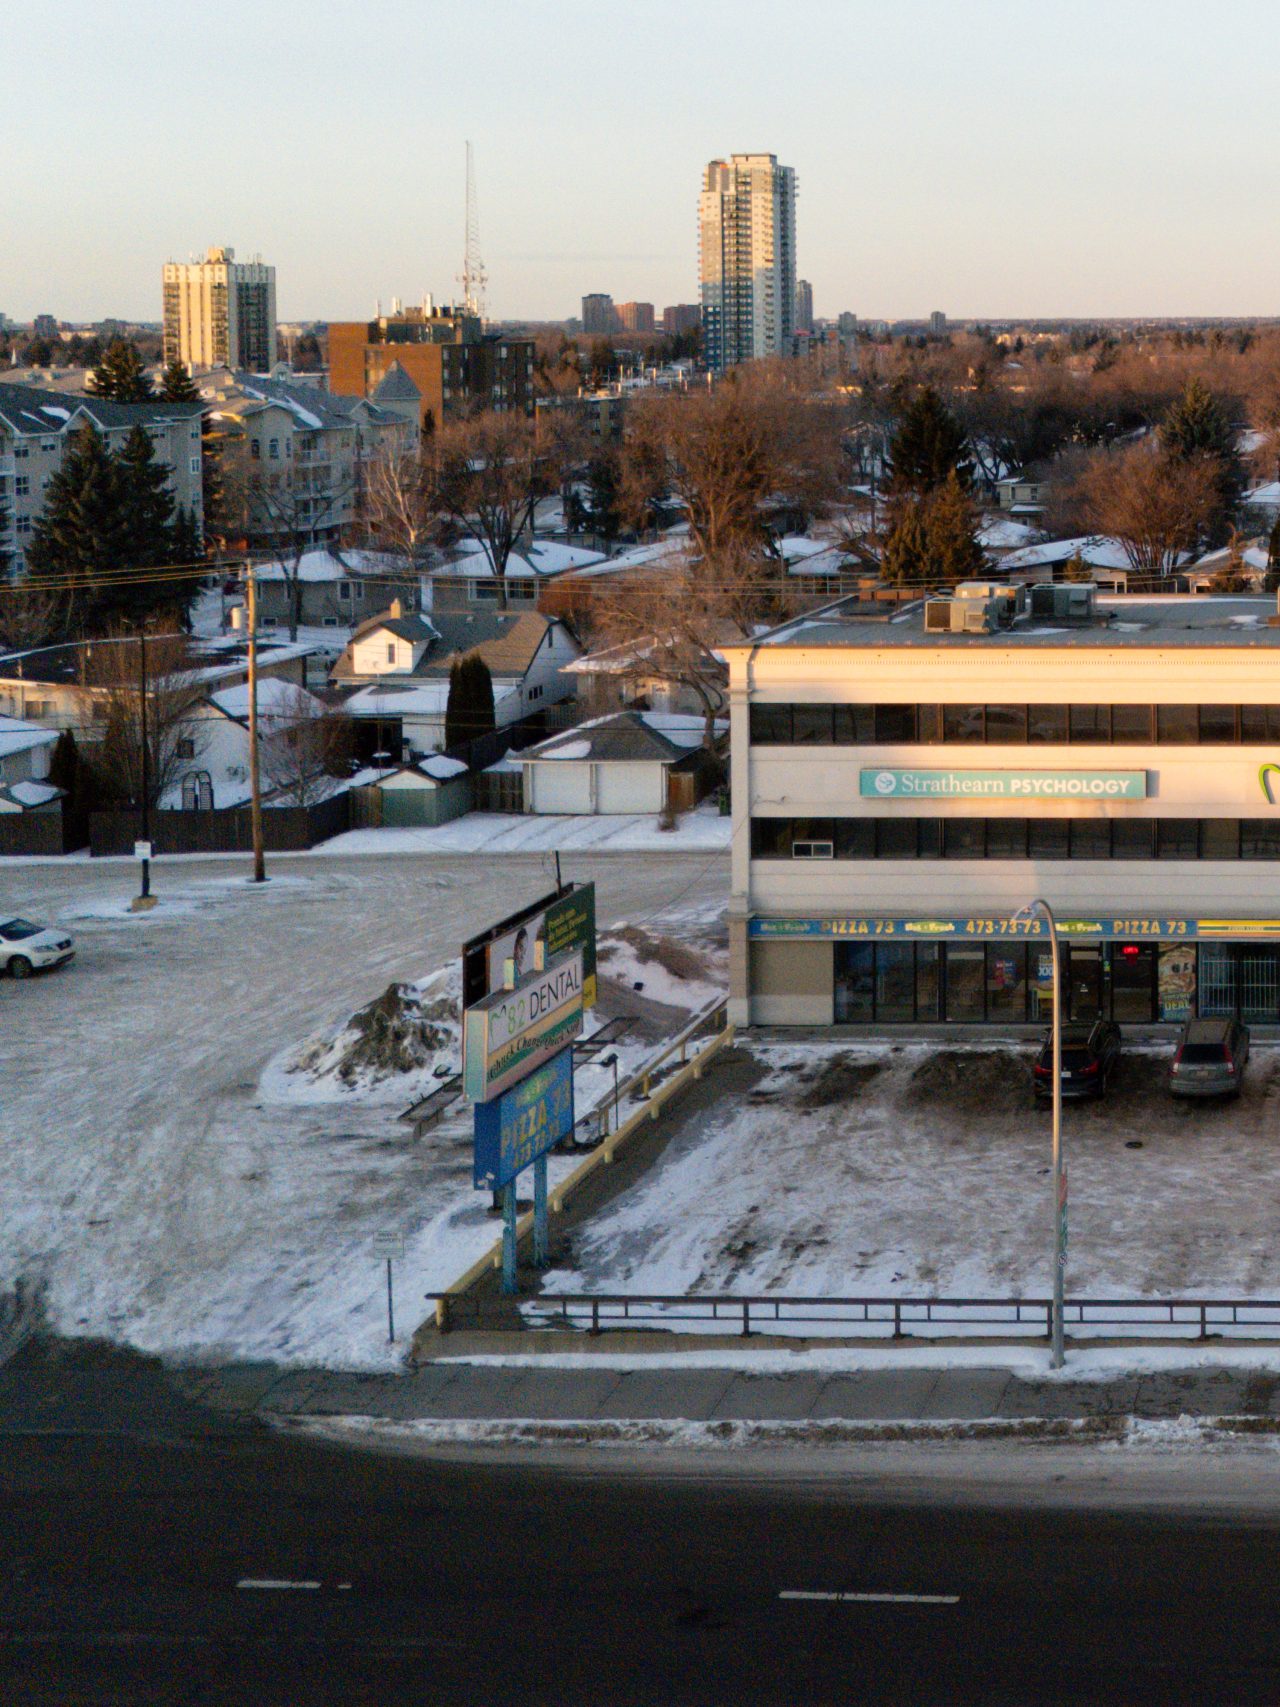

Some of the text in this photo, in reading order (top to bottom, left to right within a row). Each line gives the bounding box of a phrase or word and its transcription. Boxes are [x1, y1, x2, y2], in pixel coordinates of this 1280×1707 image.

[902, 774, 1130, 794] Strathearn PSYCHOLOGY
[821, 920, 894, 934] PIZZA 73
[1113, 920, 1187, 934] PIZZA 73
[507, 963, 581, 1035] 82 DENTAL
[501, 1098, 547, 1159] PIZZA
